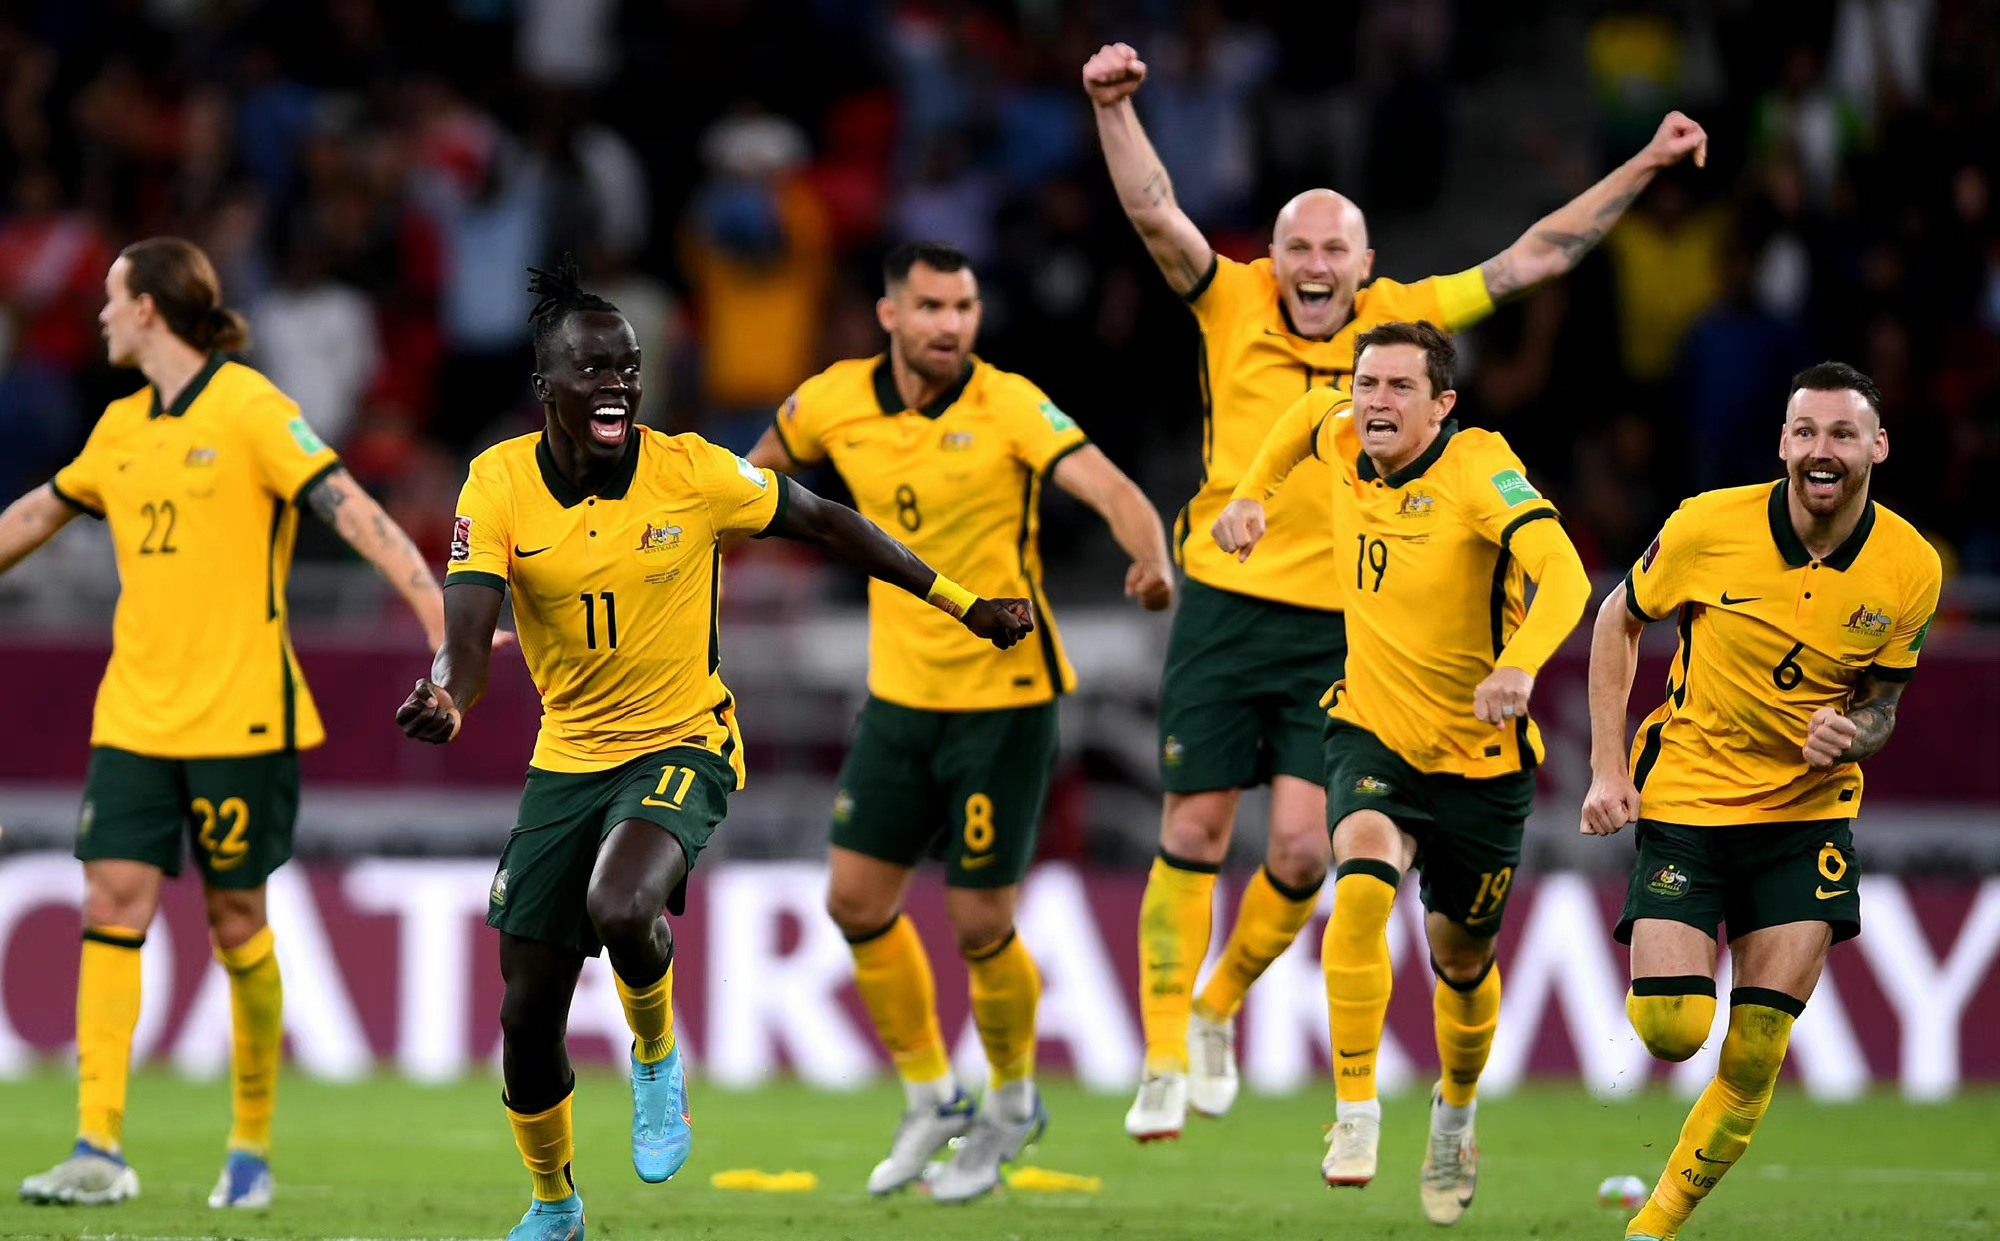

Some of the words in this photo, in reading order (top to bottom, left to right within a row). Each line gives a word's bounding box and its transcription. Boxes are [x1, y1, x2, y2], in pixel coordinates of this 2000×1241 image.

[139, 502, 177, 554] 22
[896, 485, 920, 532] 8
[1357, 533, 1387, 592] 19
[580, 592, 617, 650] 11
[1772, 641, 1805, 691] 6
[654, 765, 696, 806] 11
[191, 797, 249, 854] 22
[964, 793, 994, 851] 8
[1470, 866, 1511, 914] 19
[1341, 1064, 1371, 1077] AUS
[1680, 1168, 1717, 1189] AUS
